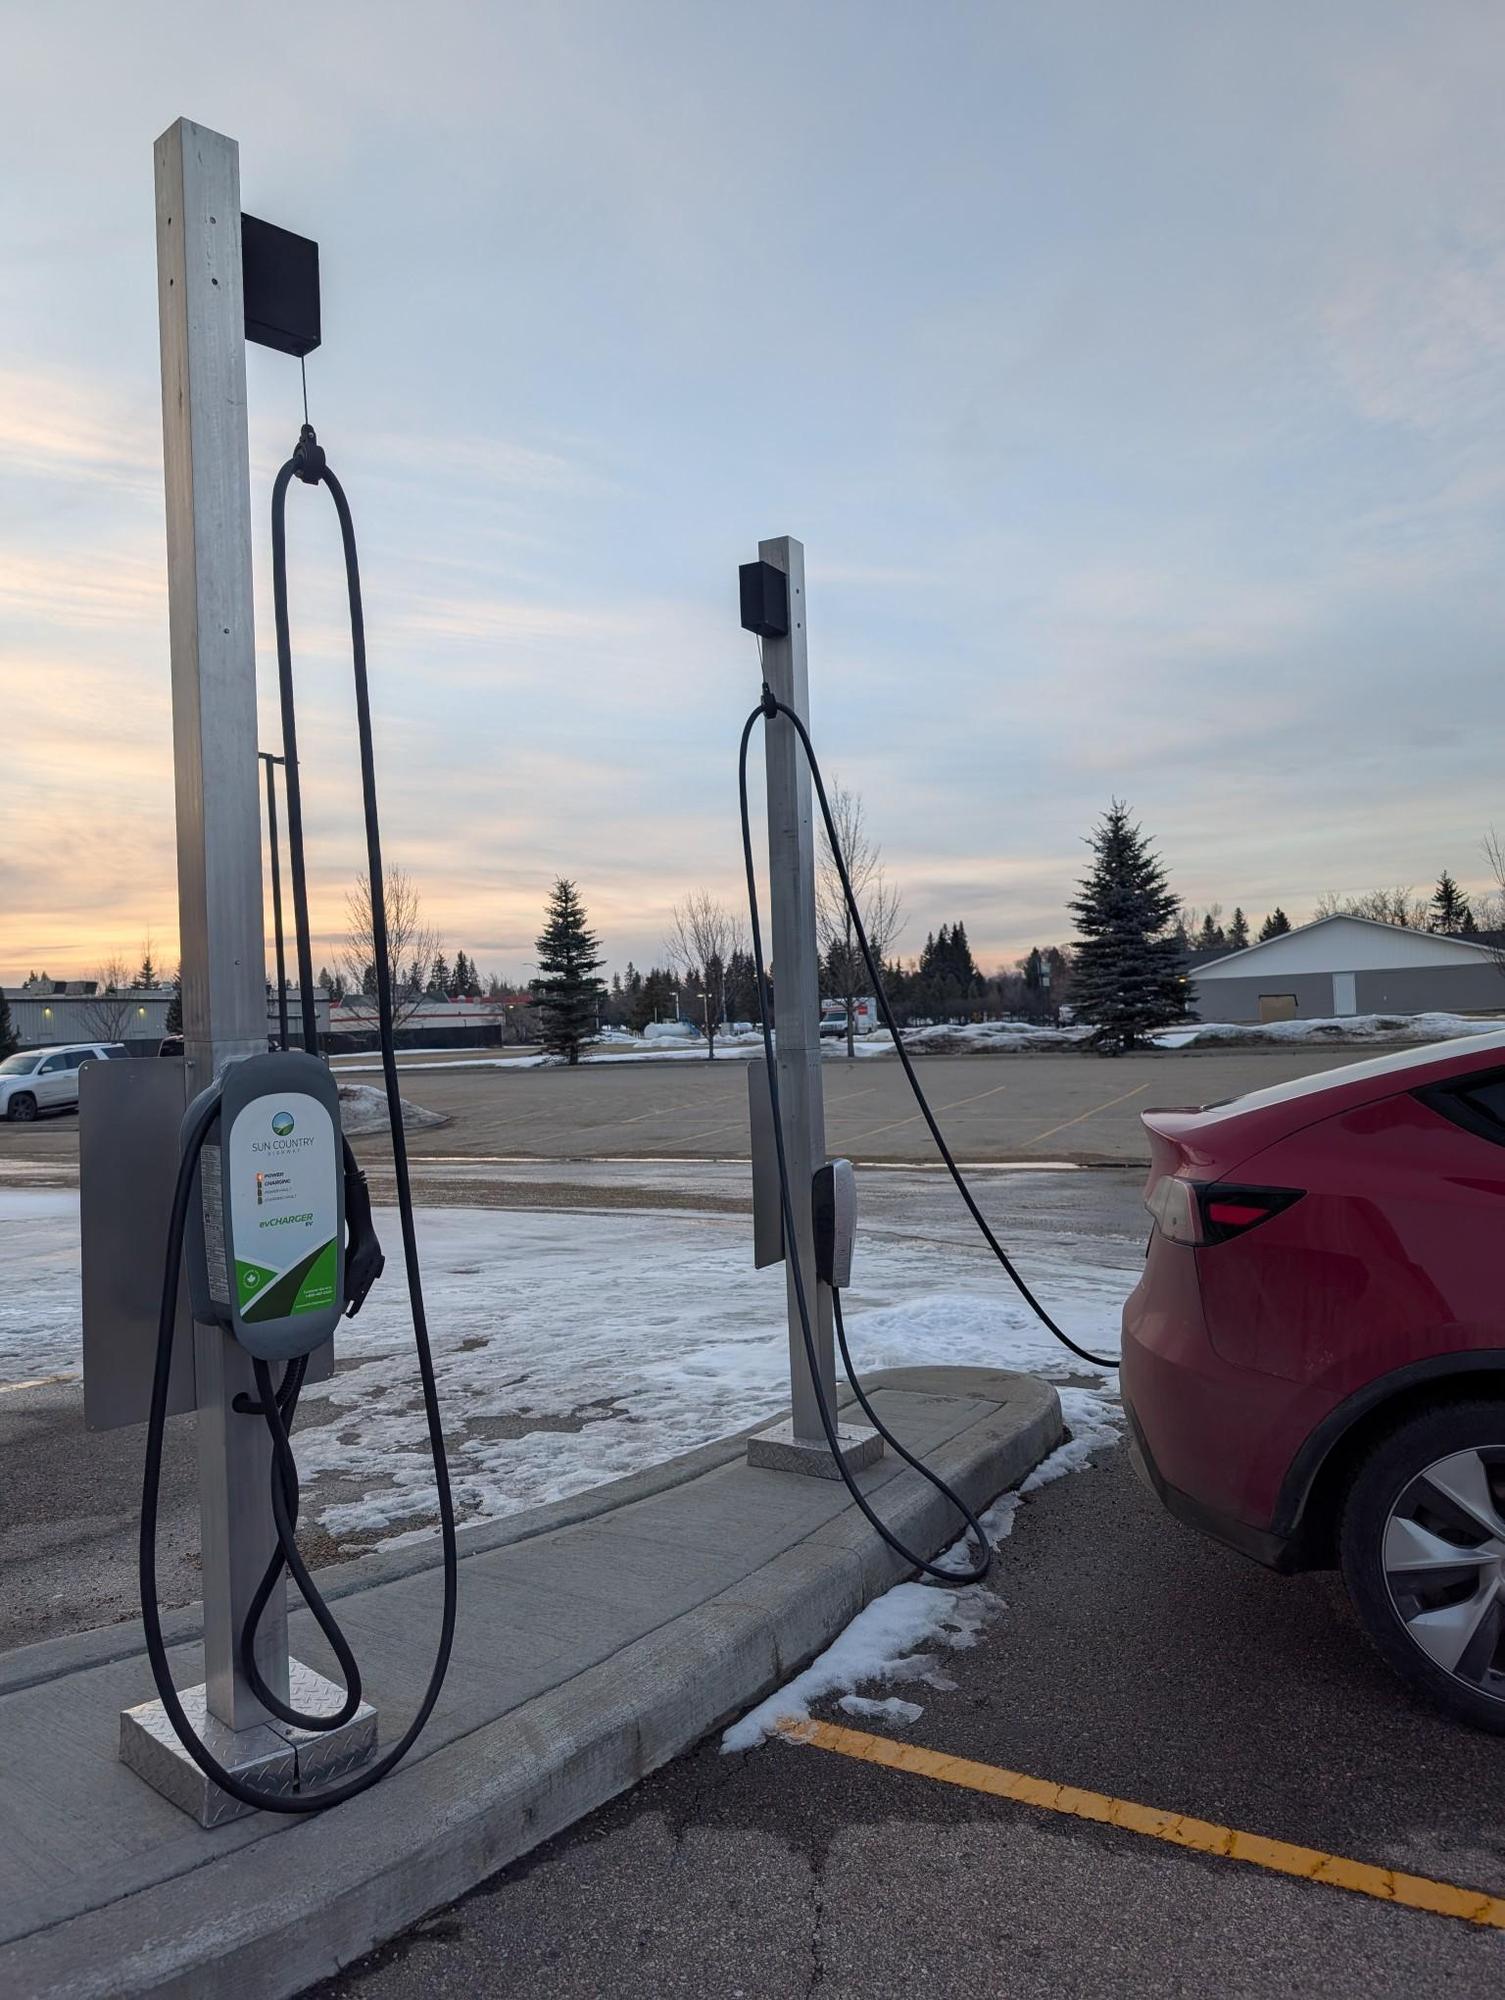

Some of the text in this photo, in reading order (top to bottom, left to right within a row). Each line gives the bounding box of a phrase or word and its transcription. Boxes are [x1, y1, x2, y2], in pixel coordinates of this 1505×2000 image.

[252, 1137, 315, 1152] SUN COUNTRY
[264, 1179, 291, 1187] CHARGING
[259, 1213, 314, 1228] evCHARGER
